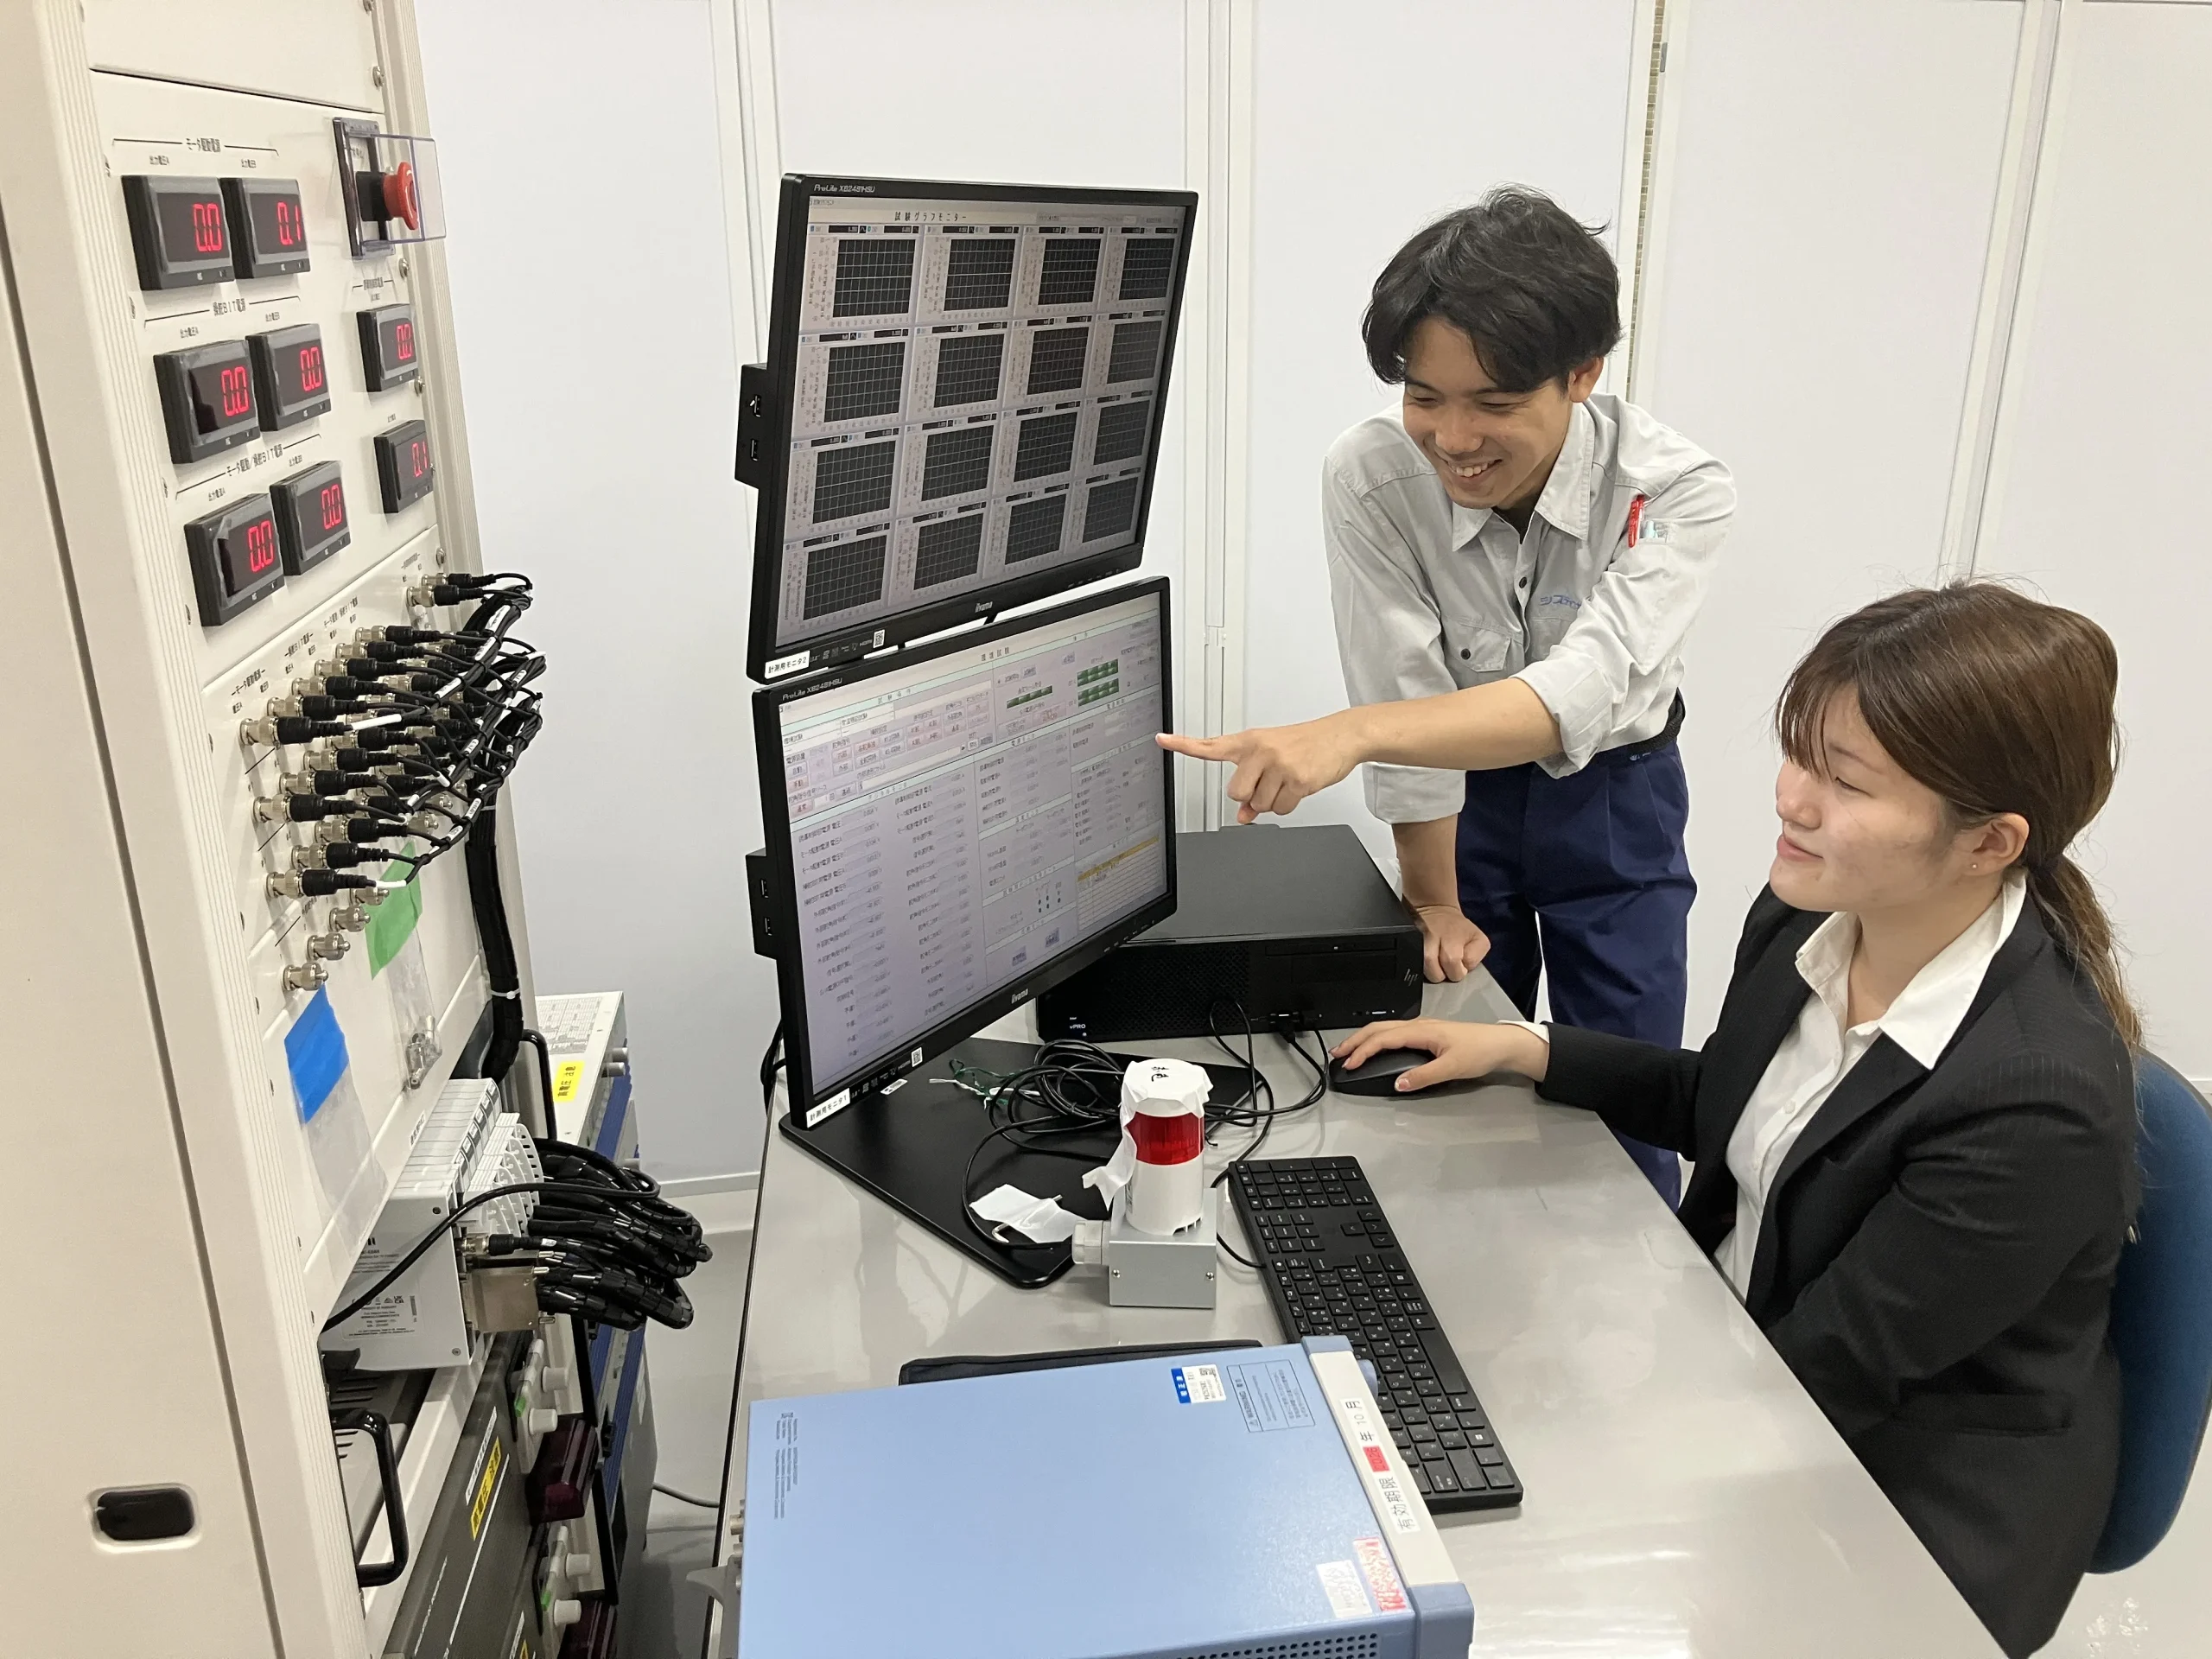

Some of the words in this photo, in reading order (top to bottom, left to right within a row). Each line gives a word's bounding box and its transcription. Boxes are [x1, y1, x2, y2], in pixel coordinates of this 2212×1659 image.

[193, 203, 223, 252] 0.0
[277, 201, 302, 246] 0.1
[894, 212, 967, 222] 試験グラフモニター
[221, 366, 250, 416] 0.0
[300, 346, 322, 392] 0.0
[321, 484, 343, 530] 0.0
[248, 519, 275, 573] 0.0
[767, 657, 807, 675] 計測用モニタ2
[782, 690, 806, 701] ProLite
[1345, 1400, 1363, 1410] 月
[1354, 1414, 1367, 1426] 10
[1359, 1431, 1375, 1442] 年
[1378, 1477, 1415, 1530] 有効期限
